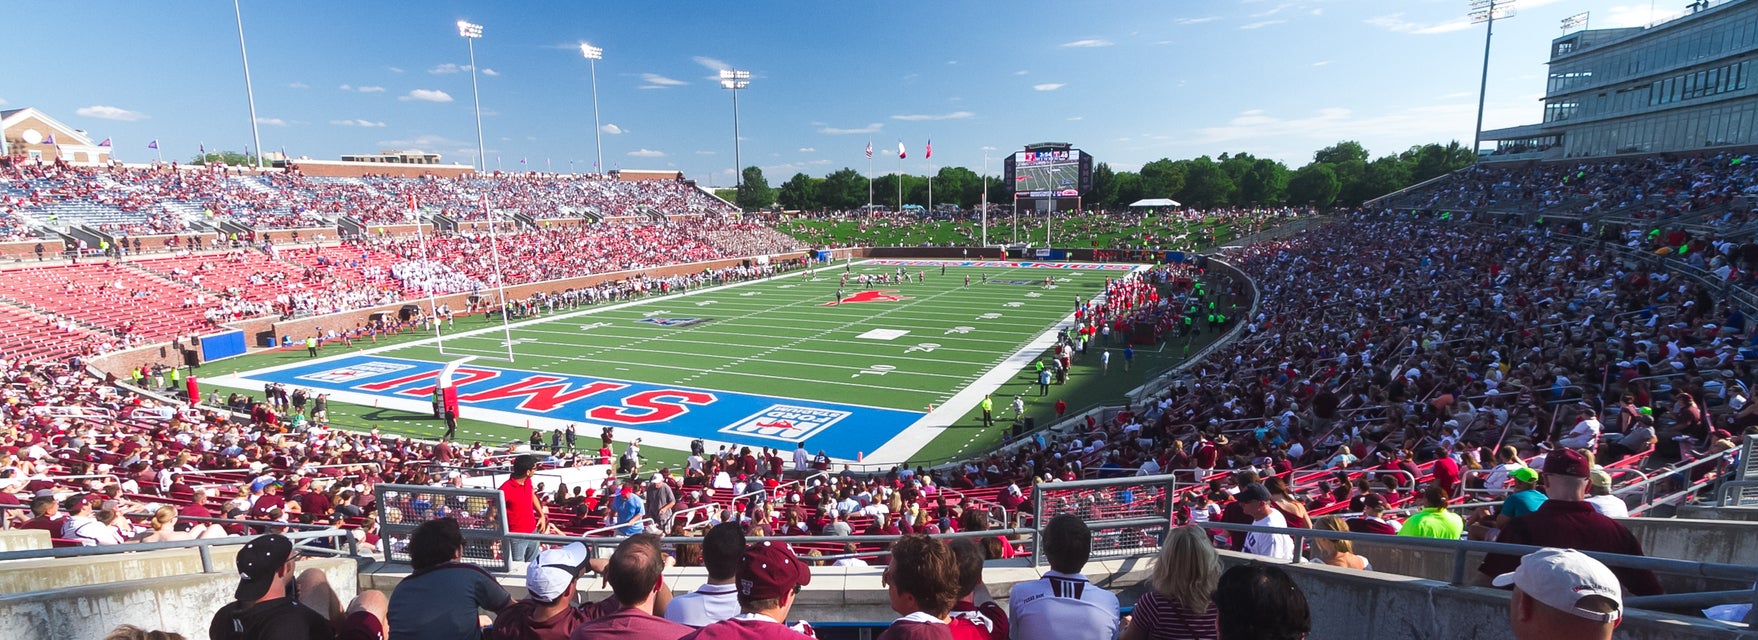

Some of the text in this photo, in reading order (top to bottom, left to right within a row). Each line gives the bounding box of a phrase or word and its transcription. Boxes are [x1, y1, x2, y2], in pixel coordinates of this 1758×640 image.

[859, 364, 897, 376] 10
[349, 367, 719, 425] SMU
[767, 411, 831, 422] FORD
[775, 406, 841, 417] STADIUM
[815, 455, 826, 464] 12
